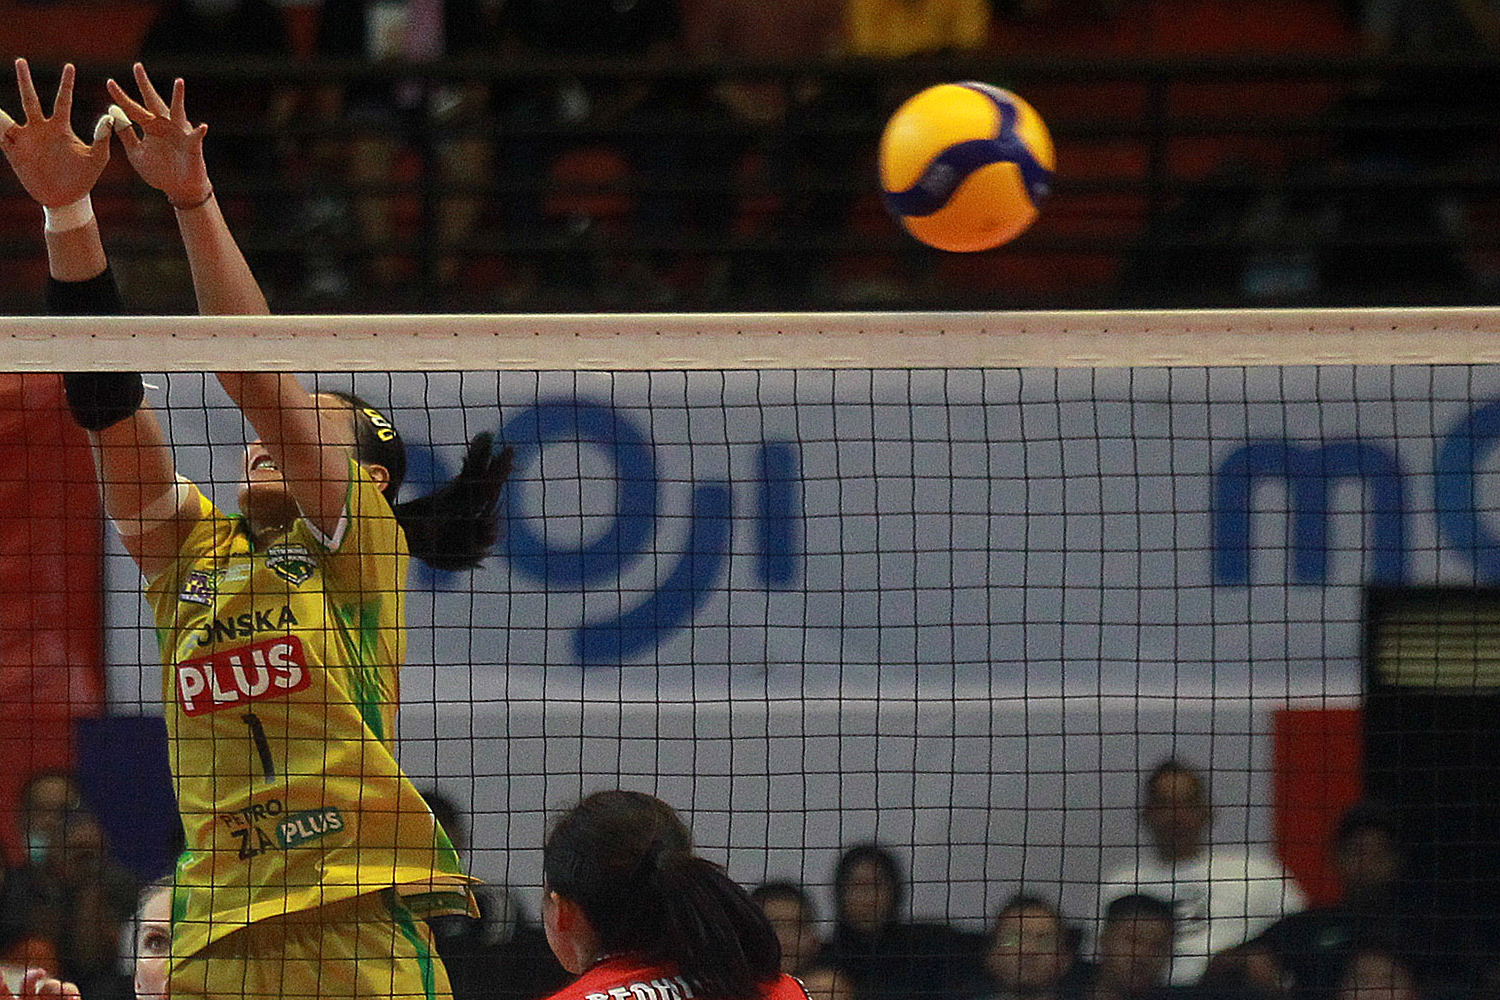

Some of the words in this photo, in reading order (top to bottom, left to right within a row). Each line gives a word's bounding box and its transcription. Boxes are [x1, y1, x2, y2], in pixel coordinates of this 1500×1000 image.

[179, 643, 303, 711] PLUS
[241, 713, 275, 784] 1
[219, 799, 282, 829] PETRO
[281, 811, 342, 843] PLUS
